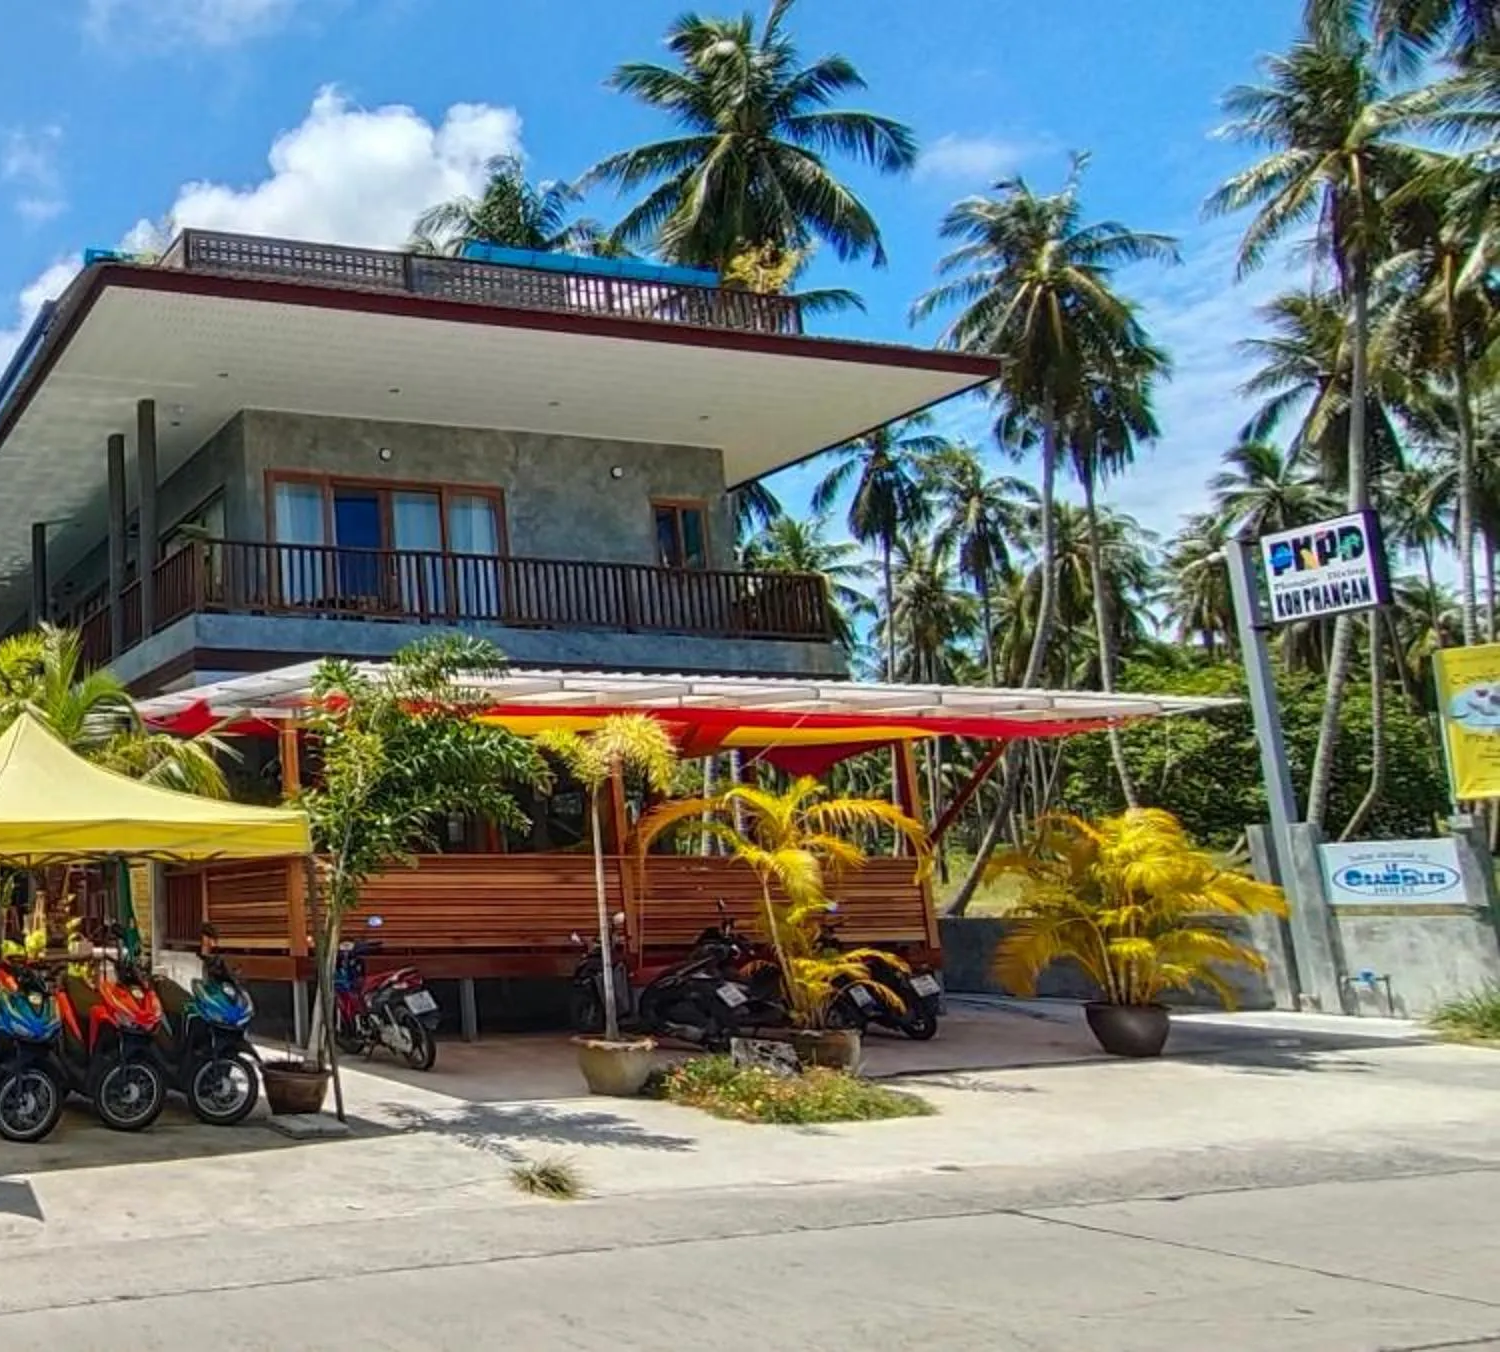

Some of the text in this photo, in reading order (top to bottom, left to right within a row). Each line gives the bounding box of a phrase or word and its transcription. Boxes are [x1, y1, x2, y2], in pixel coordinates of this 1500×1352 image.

[1270, 525, 1365, 576] PKPD
[1275, 575, 1372, 618] KOH PHANGAN
